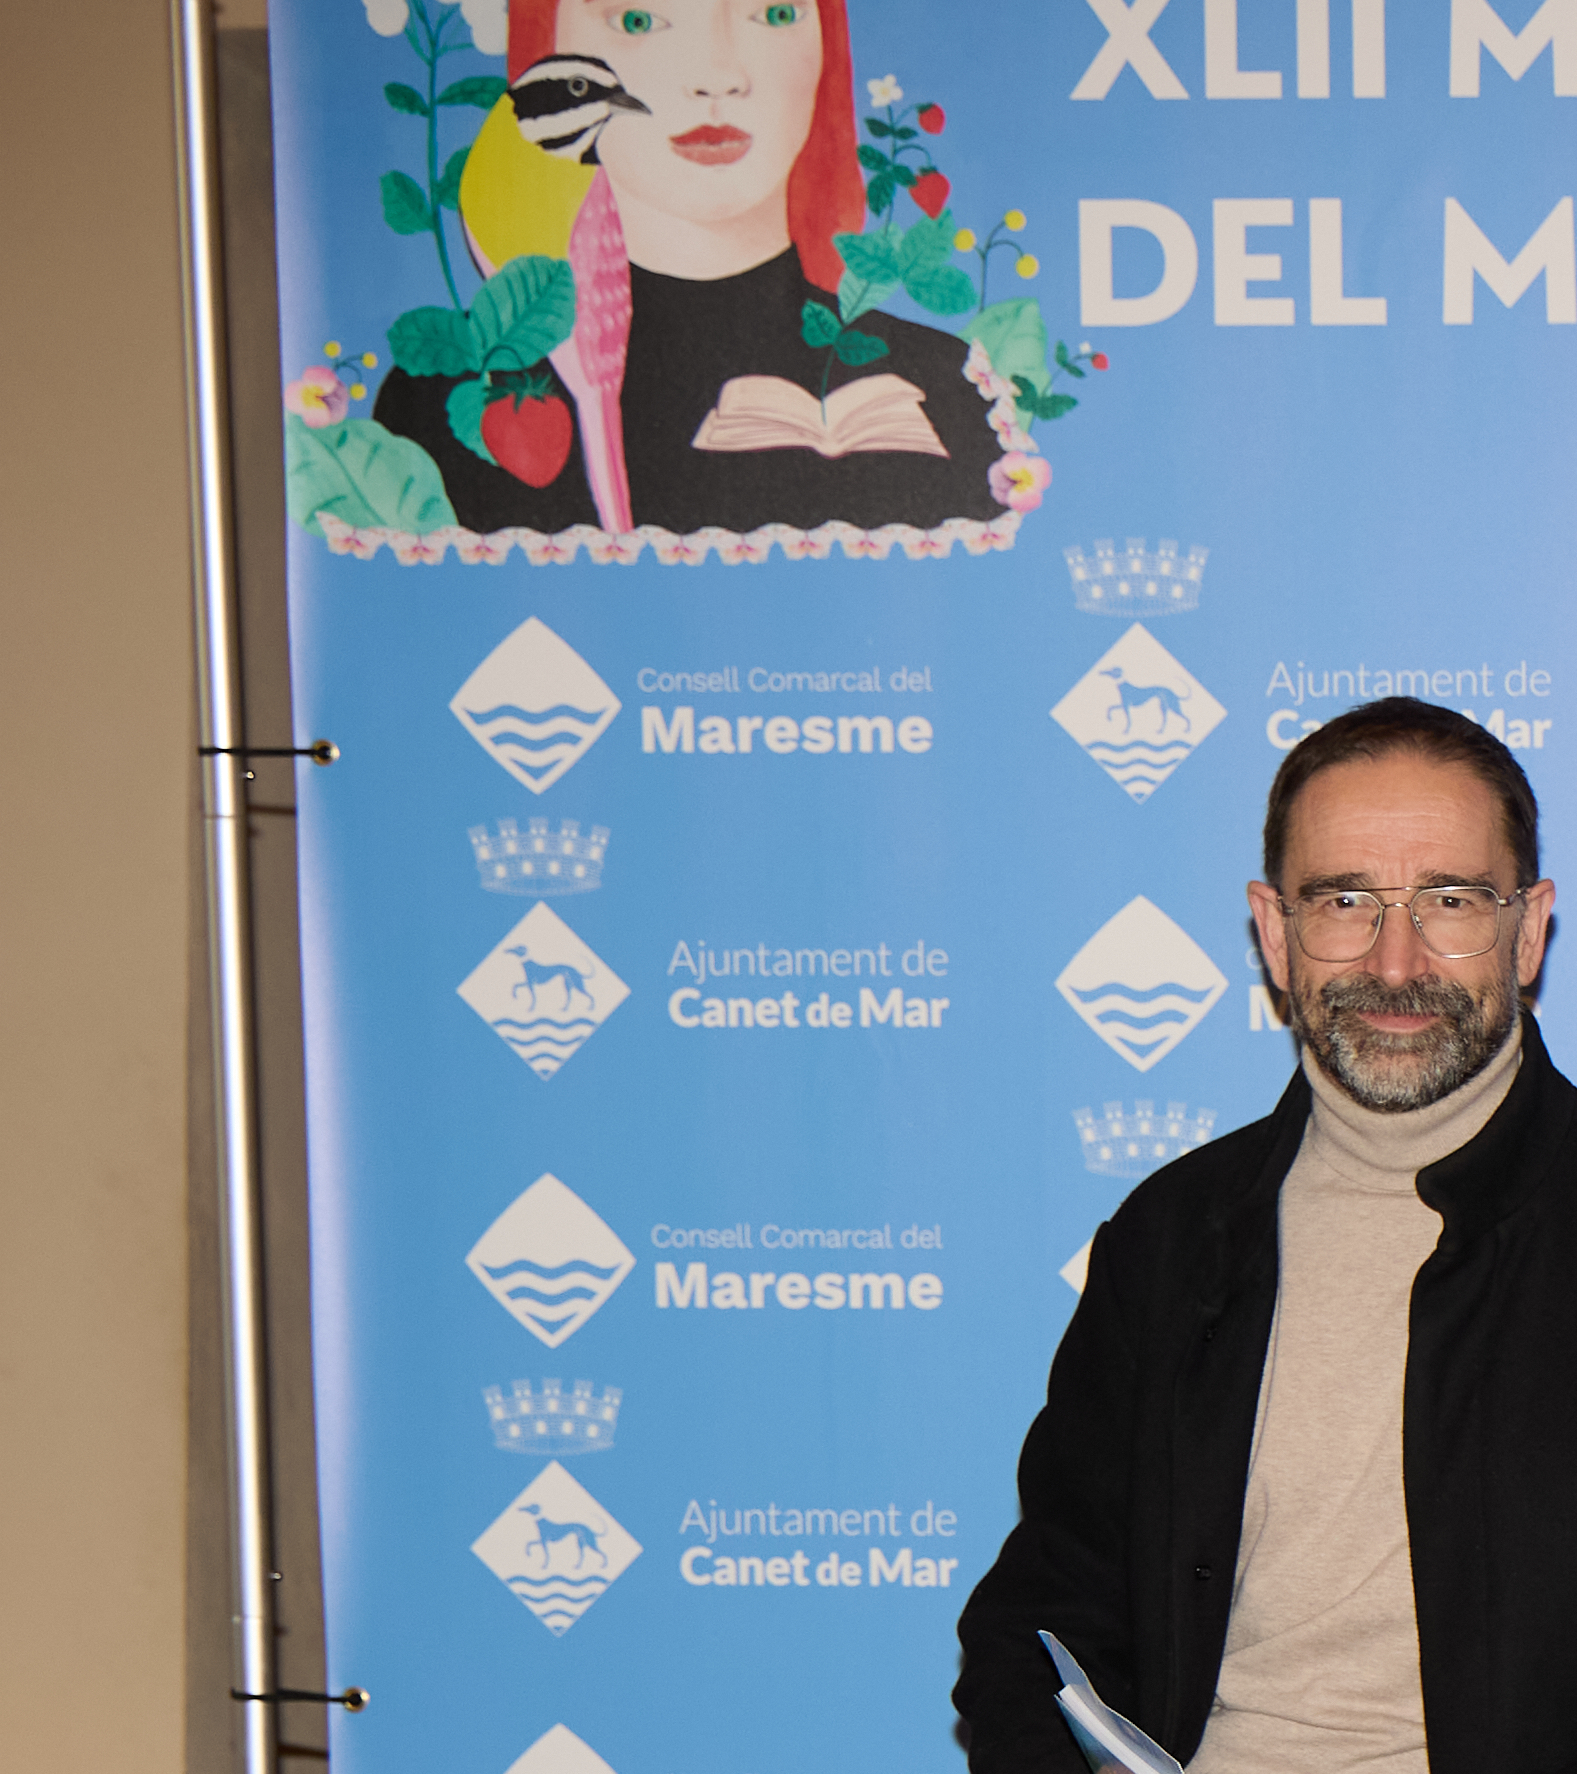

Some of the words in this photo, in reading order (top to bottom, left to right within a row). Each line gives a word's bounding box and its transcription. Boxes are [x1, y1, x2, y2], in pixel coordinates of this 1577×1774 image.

[1070, 0, 1387, 101] XLII
[1078, 197, 1388, 327] DEL
[636, 665, 741, 693] Consell
[747, 665, 884, 693] Comarcal
[888, 664, 934, 694] del
[1265, 660, 1495, 706] Ajuntament
[1503, 659, 1553, 698] de
[641, 705, 934, 754] Maresme
[667, 939, 893, 982] Ajuntament
[900, 938, 950, 978] de
[668, 986, 801, 1028] Canet
[805, 992, 854, 1028] de
[859, 987, 951, 1028] Mar
[650, 1222, 754, 1249] Consell
[759, 1223, 894, 1250] Comarcal
[899, 1223, 944, 1250] del
[655, 1261, 944, 1311] Maresme
[679, 1499, 902, 1541] Ajuntament
[909, 1499, 958, 1538] de
[680, 1545, 811, 1587] Canet
[815, 1551, 863, 1587] de
[868, 1547, 959, 1588] Mar
